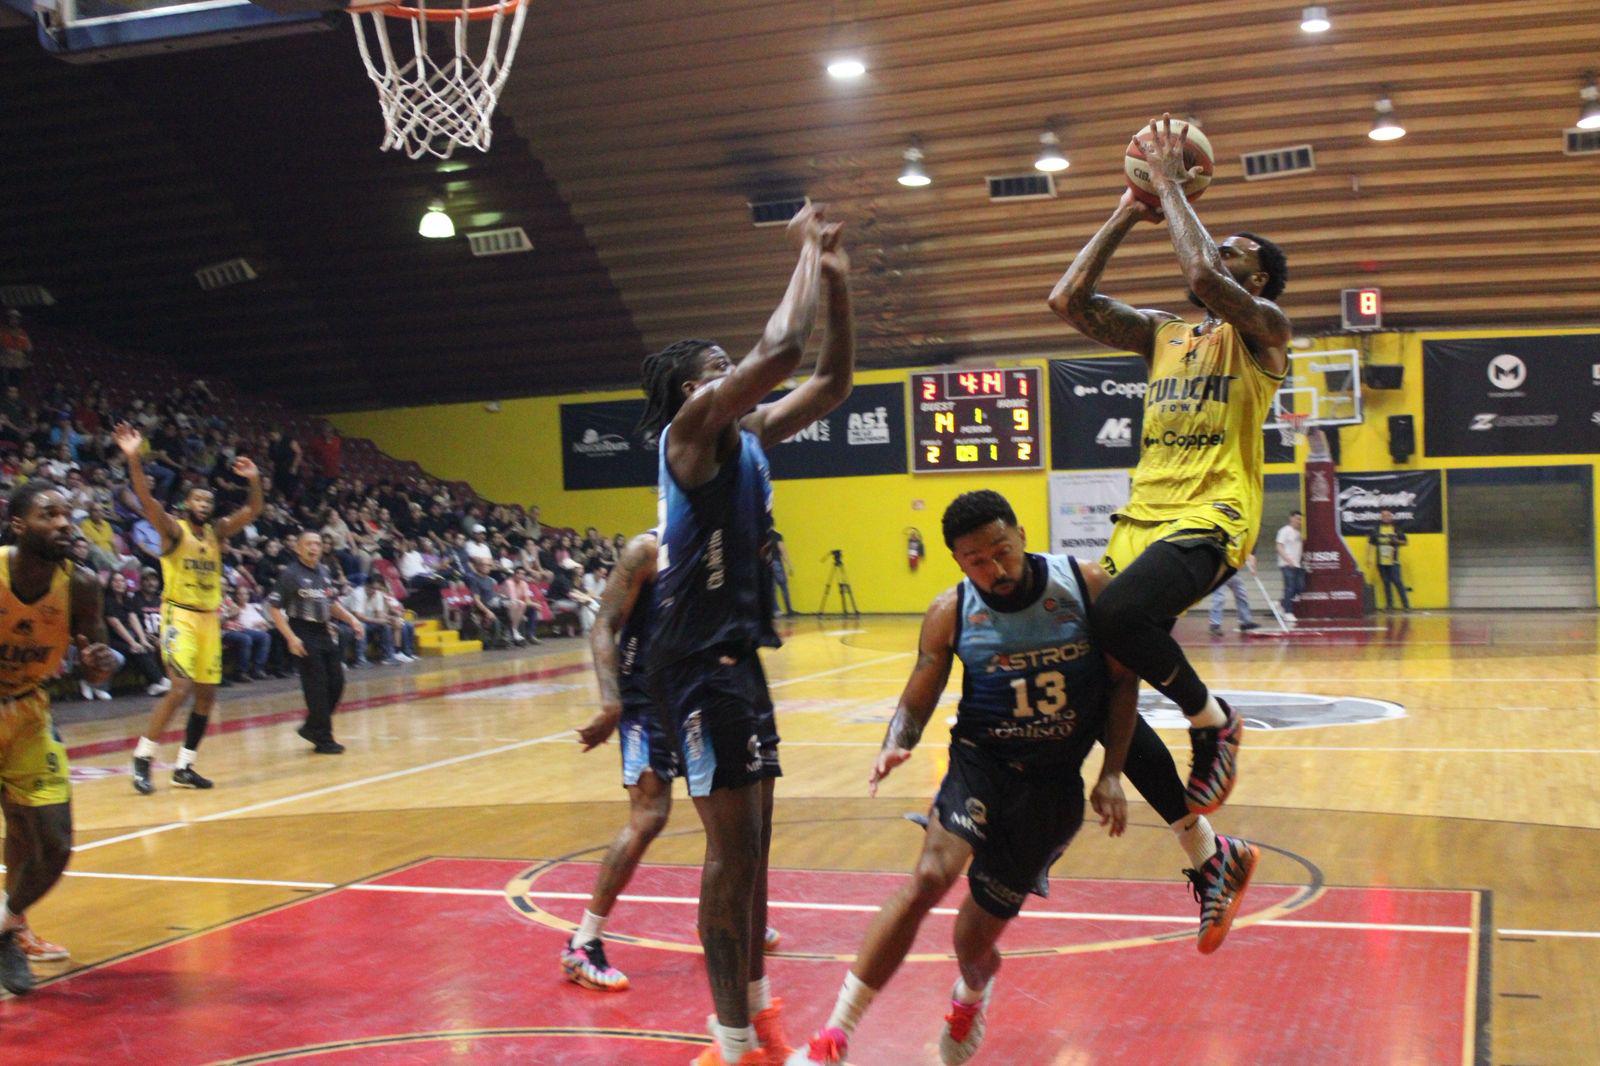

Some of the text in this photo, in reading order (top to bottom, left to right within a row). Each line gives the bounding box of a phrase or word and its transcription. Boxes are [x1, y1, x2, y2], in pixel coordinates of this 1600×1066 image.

[1360, 292, 1376, 315] 8
[923, 383, 936, 400] 2
[1018, 379, 1028, 396] 1
[1101, 379, 1148, 399] Copp
[974, 407, 983, 424] 1
[1012, 408, 1029, 431] 9
[926, 446, 940, 463] 2
[1018, 443, 1031, 461] 2
[1062, 538, 1108, 548] BIENVENID
[986, 642, 1091, 673] ASTROS
[1010, 670, 1067, 718] 13
